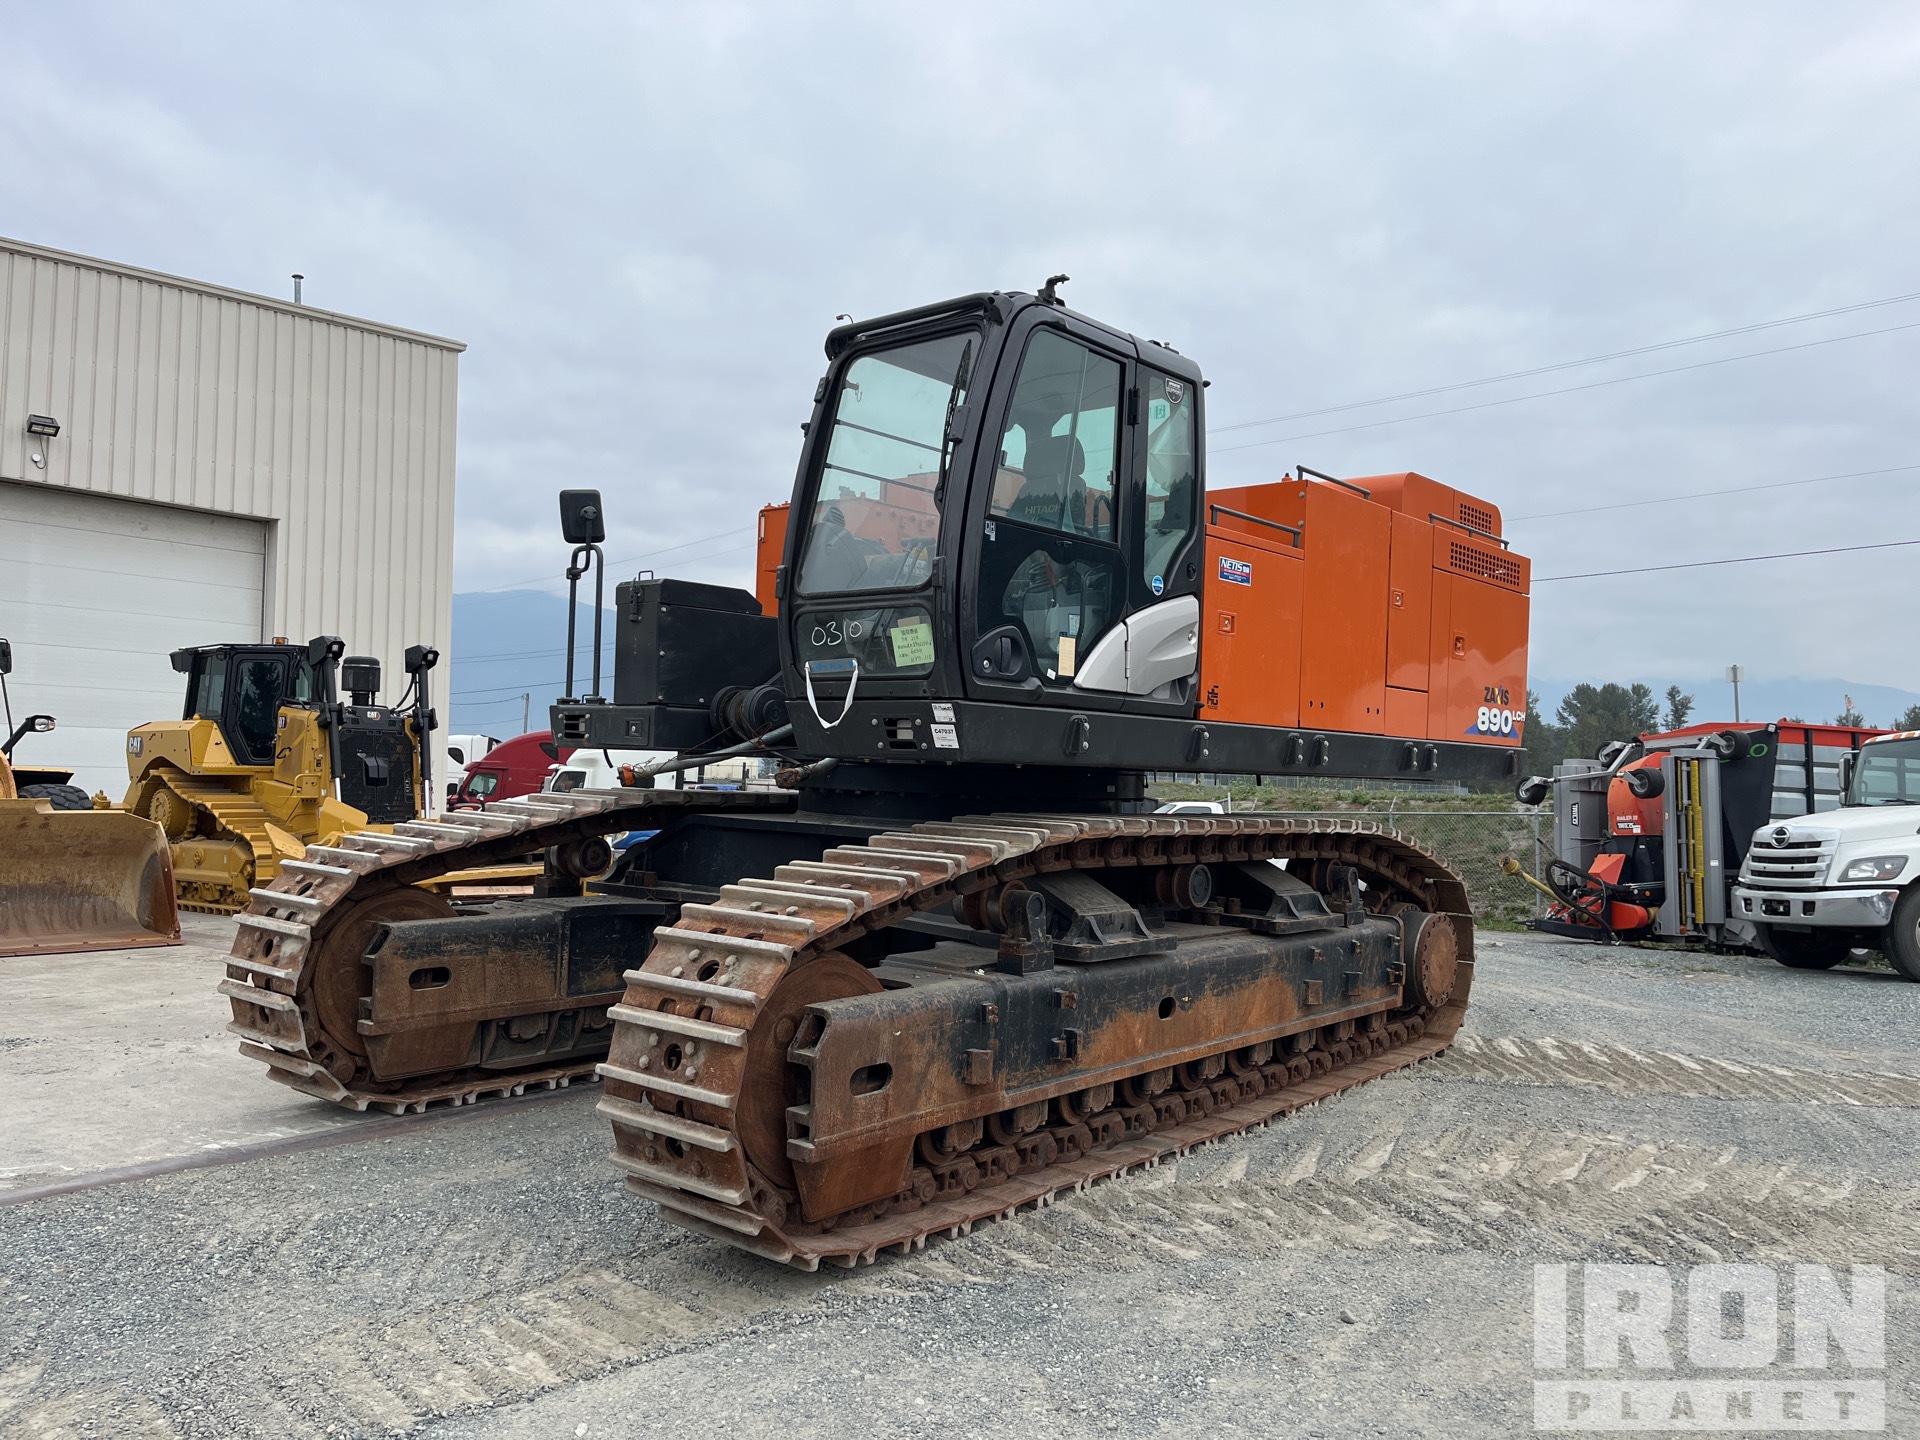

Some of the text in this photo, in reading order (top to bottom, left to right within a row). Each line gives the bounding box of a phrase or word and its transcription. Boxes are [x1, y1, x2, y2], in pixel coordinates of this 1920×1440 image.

[1024, 504, 1059, 515] HITACH
[1220, 558, 1243, 572] NETIS
[811, 621, 862, 646] 0310
[1477, 706, 1512, 735] 890
[128, 736, 142, 753] CAT
